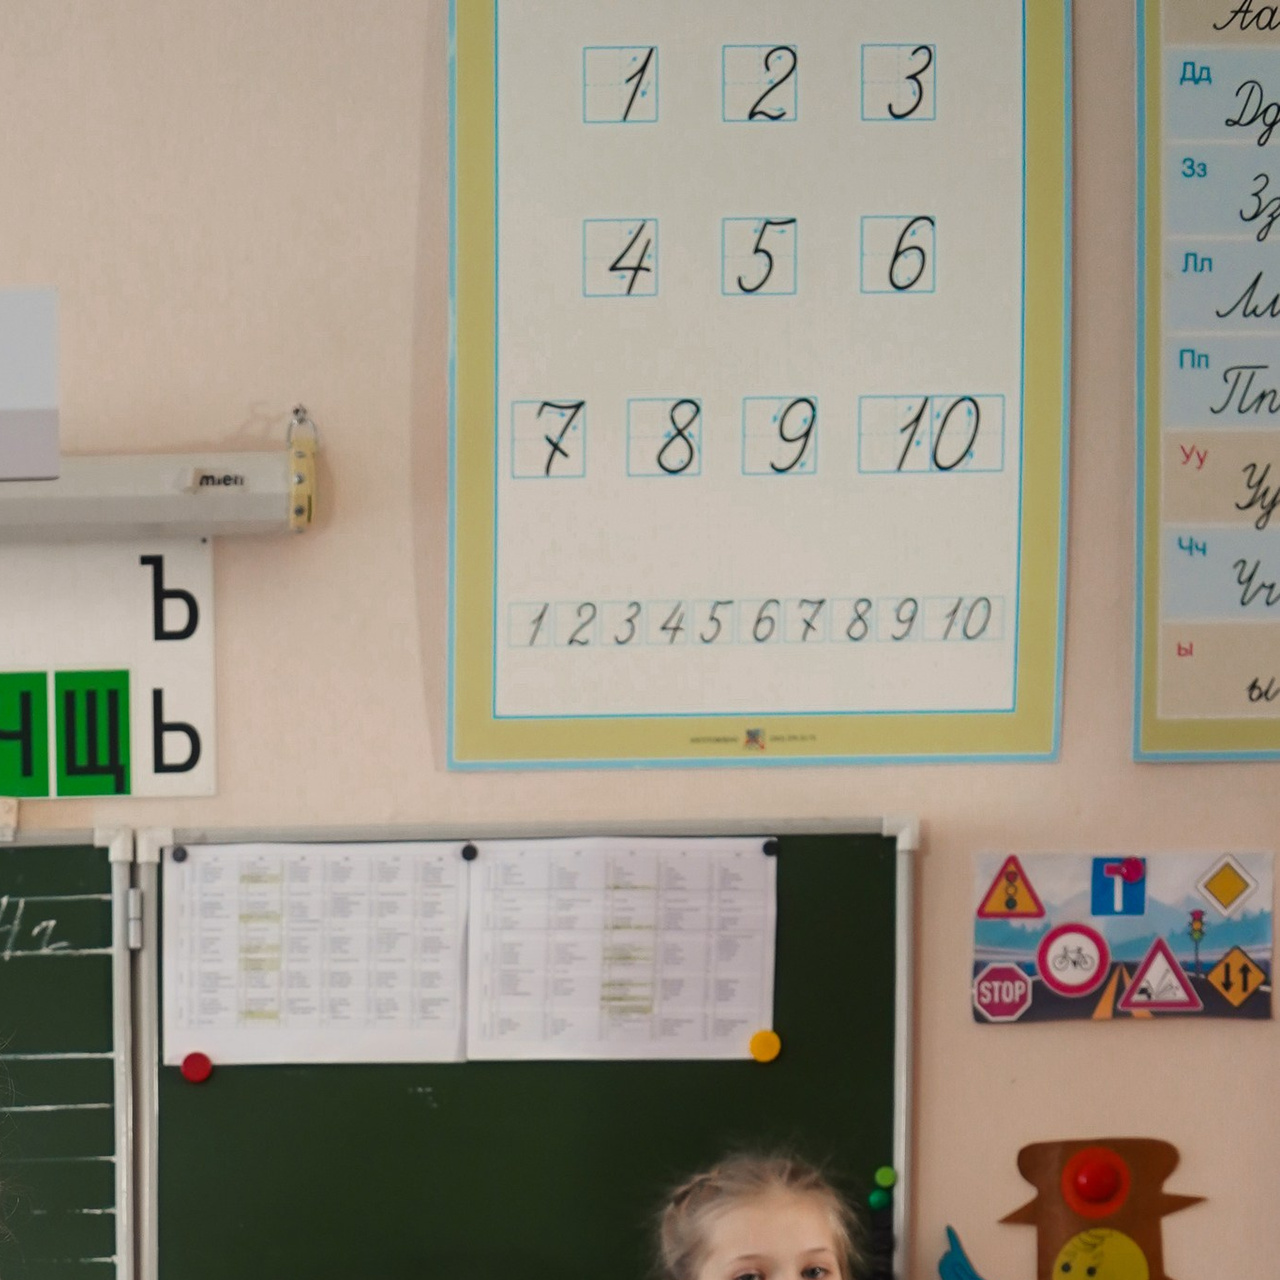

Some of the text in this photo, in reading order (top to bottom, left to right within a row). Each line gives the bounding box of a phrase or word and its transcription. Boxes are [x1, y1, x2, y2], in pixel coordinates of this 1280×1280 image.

[624, 45, 933, 121] 1 2 3
[1180, 61, 1212, 86] Дд
[1181, 157, 1208, 179] Зз
[608, 215, 935, 296] 4 5 6
[1182, 252, 1213, 272] Лл
[1179, 349, 1210, 370] Пп
[536, 396, 981, 477] 7 8 9 10
[1179, 444, 1209, 470] Уу
[1178, 536, 1207, 557] Чч
[140, 555, 200, 641] Ъ
[529, 596, 992, 646] 1 2 3 4 5 6 7 8 9 10
[1177, 641, 1194, 657] ы
[62, 689, 126, 795] Щ
[152, 688, 202, 774] Ь
[978, 980, 1026, 1005] STOP
